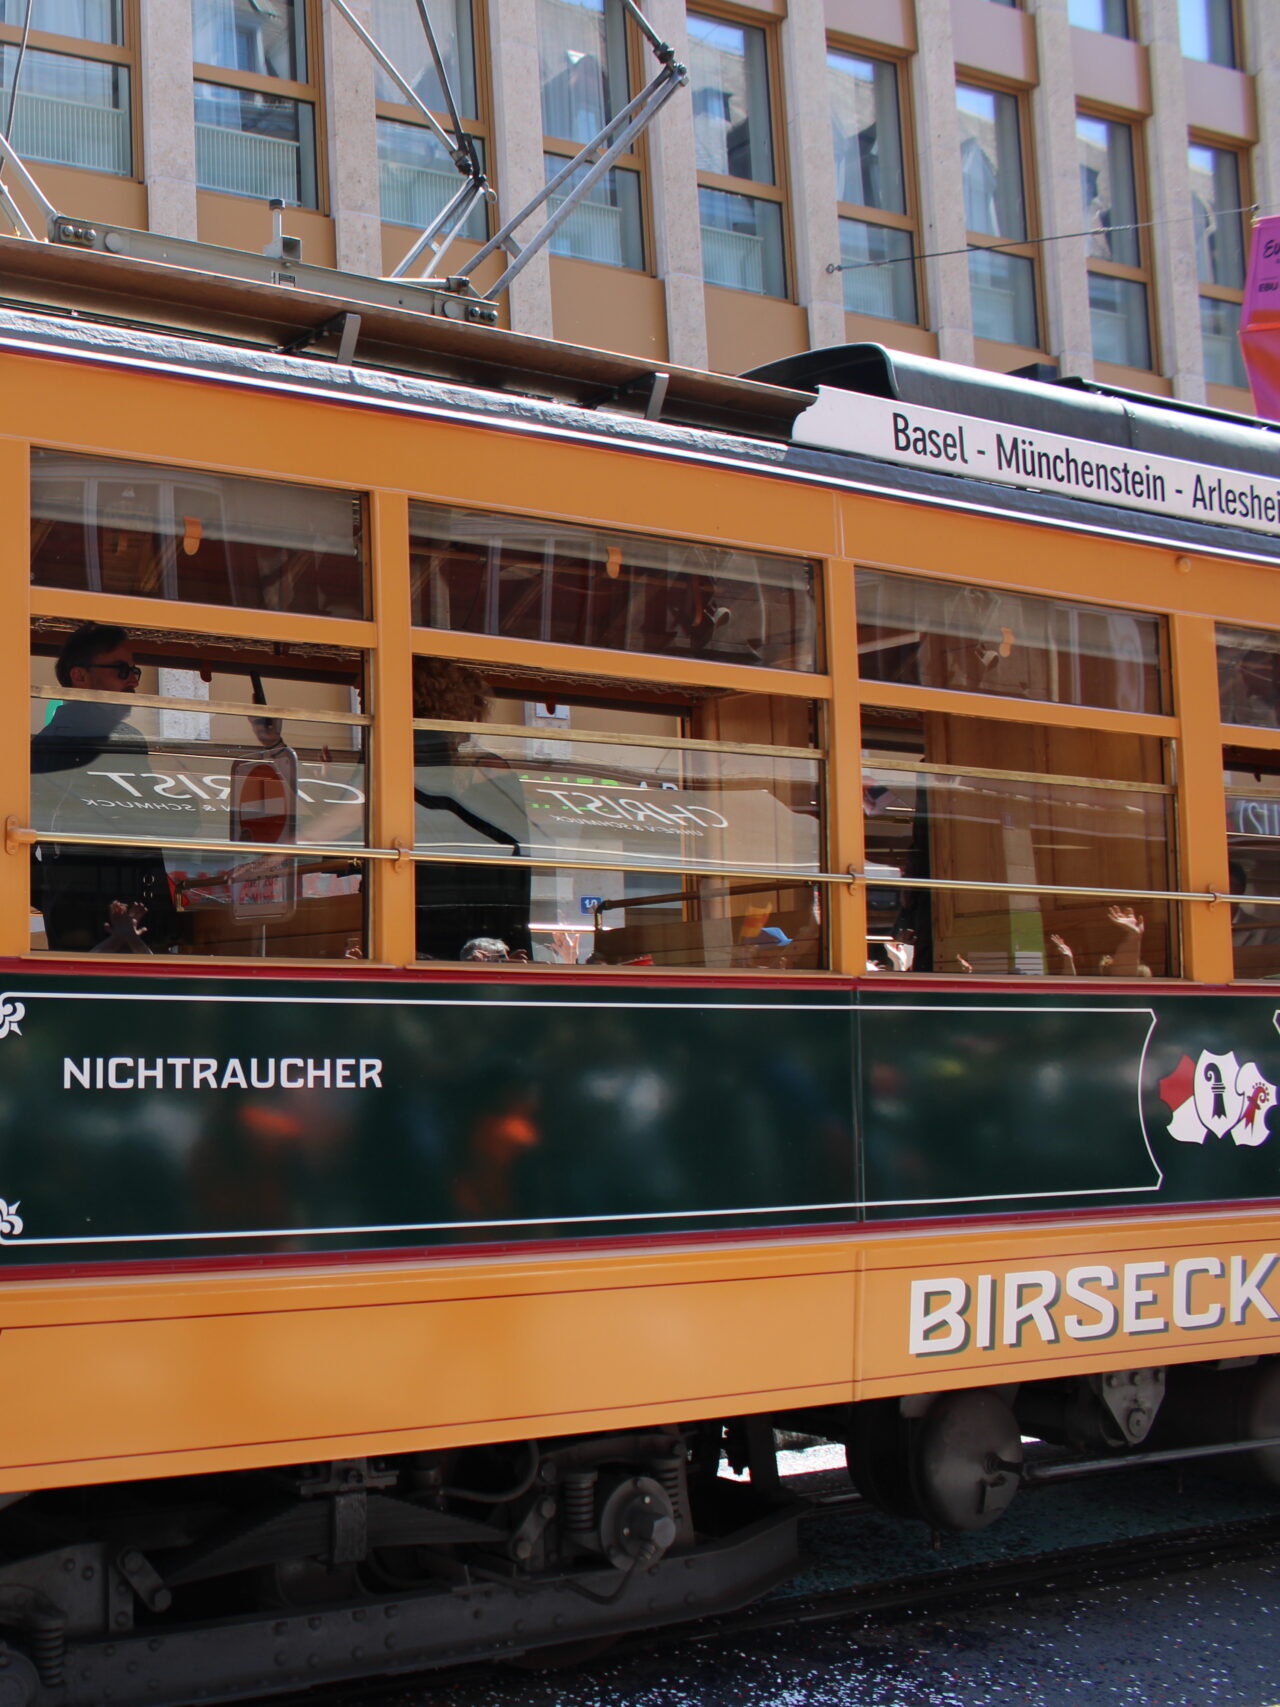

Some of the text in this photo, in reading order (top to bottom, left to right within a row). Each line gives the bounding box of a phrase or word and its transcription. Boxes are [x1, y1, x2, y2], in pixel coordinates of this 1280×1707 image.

[892, 412, 968, 464] Basel
[995, 433, 1166, 502] Münchenstein
[63, 1057, 383, 1089] NICHTRAUCHER
[908, 1252, 1280, 1358] BIRSECK
